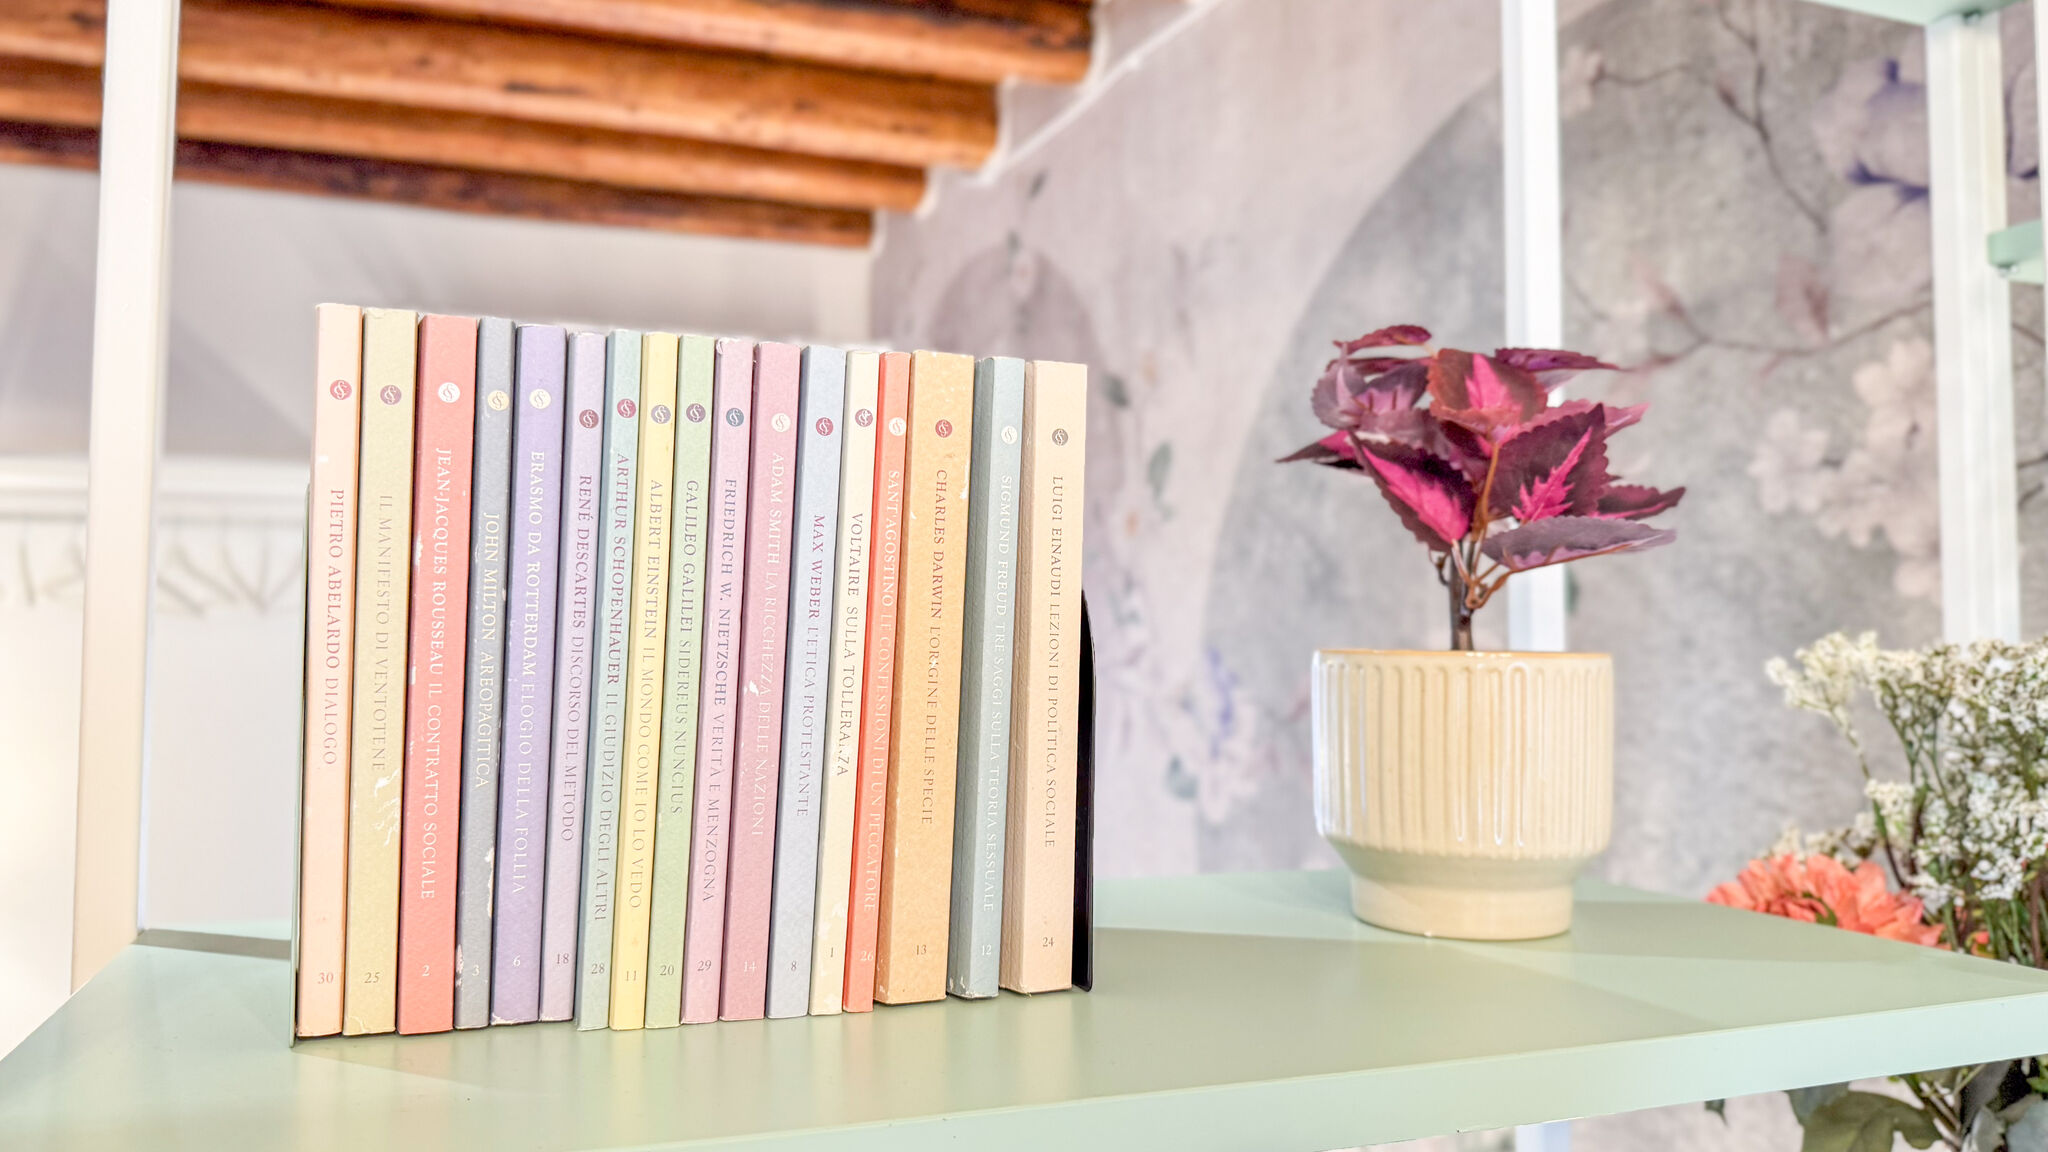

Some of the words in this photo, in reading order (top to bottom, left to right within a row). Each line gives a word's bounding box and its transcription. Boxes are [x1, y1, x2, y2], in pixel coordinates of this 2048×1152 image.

[379, 495, 393, 512] IL
[527, 451, 545, 525] ERASMO
[577, 475, 594, 521] RENÉ
[613, 453, 629, 530] ARTHUR
[769, 453, 785, 504] ADAM
[933, 469, 948, 545] CHARLES
[1051, 476, 1063, 521] LUIGI
[328, 489, 345, 559] PIETRO
[431, 448, 452, 575] JEAN-JACQUES
[483, 512, 500, 562] JOHN
[648, 479, 663, 549] ALBERT
[683, 480, 699, 556] GALILEO
[720, 479, 737, 575] FRIEDRICH
[766, 509, 782, 564] SMITH
[812, 515, 826, 553] MAX
[881, 470, 900, 607] SANT'AGOSTINO
[998, 475, 1013, 555] SIGMUND
[374, 517, 393, 625] MANIFESTO
[527, 532, 542, 556] DA
[847, 513, 863, 597] VOLTAIRE
[1049, 527, 1062, 597] EINAUDI
[481, 568, 498, 641] MILTON
[573, 528, 590, 629] DESCARTES
[644, 555, 660, 639] EINSTEIN
[680, 562, 695, 633] GALILEI
[719, 581, 732, 601] W.
[764, 572, 778, 591] LA
[808, 559, 823, 619] WEBER
[930, 551, 945, 619] DARWIN
[996, 560, 1009, 616] FREUD
[325, 565, 342, 670] ABELARDO
[428, 581, 446, 676] ROUSSEAU
[520, 562, 541, 676] ROTTERDAM
[607, 536, 626, 685] SCHOPENHAUER
[843, 606, 858, 659] SULLA
[880, 614, 893, 634] LE
[994, 624, 1006, 651] TRE
[1048, 604, 1061, 668] LEZIONI
[374, 632, 389, 650] DI
[642, 647, 655, 665] IL
[713, 608, 731, 706] NIETZSCHE
[758, 597, 777, 695] RICCHEZZA
[803, 627, 819, 688] L'ETICA
[426, 683, 442, 698] IL
[568, 636, 584, 723] DISCORSO
[606, 693, 618, 709] IL
[638, 669, 654, 738] MONDO
[675, 639, 691, 725] SIDEREUS
[871, 637, 891, 751] CONFESSIONI
[992, 656, 1004, 705] SAGGI
[1047, 675, 1059, 691] DI
[322, 678, 339, 765] DIALOGO
[371, 658, 389, 772] VENTOTENE
[475, 652, 495, 789] AREOPAGITICA
[517, 682, 535, 756] ELOGIO
[755, 702, 773, 752] DELLE
[836, 665, 855, 776] TOLLERAZA
[924, 714, 937, 764] DELLE
[989, 711, 1001, 761] SULLA
[1046, 698, 1058, 774] POLITICA
[423, 704, 441, 817] CONTRATTO
[565, 728, 579, 761] DEL
[601, 714, 618, 803] GIUDIZIO
[634, 743, 650, 796] COME
[670, 730, 686, 814] NUNCIUS
[796, 695, 815, 817] PROTESTANTE
[871, 758, 884, 774] DI
[514, 762, 532, 820] DELLA
[561, 766, 577, 841] METODO
[633, 803, 647, 822] IO
[708, 784, 721, 792] E
[751, 758, 769, 836] NAZIONI
[870, 782, 883, 804] UN
[921, 768, 935, 825] SPECIE
[986, 767, 1000, 829] TEORIA
[1044, 779, 1056, 848] SOCIALE
[420, 821, 437, 900] SOCIALE
[511, 827, 530, 894] FOLLIA
[597, 810, 613, 862] DEGLI
[631, 829, 645, 851] LO
[702, 799, 721, 901] MENZOGNA
[864, 813, 881, 912] PECCATORE
[594, 869, 608, 921] ALTRI
[629, 858, 644, 909] VEDO
[983, 835, 997, 912] SESSUALE
[422, 965, 430, 977] 2
[472, 964, 480, 976] 3
[513, 955, 521, 967] 6
[555, 953, 570, 964] 18
[591, 963, 605, 974] 28
[659, 964, 675, 976] 20
[697, 960, 712, 972] 29
[743, 961, 757, 972] 14
[790, 961, 797, 972] 8
[829, 947, 834, 958] 1
[860, 951, 874, 962] 26
[916, 944, 927, 955] 13
[981, 944, 992, 955] 12
[1042, 937, 1054, 948] 24
[318, 972, 334, 984] 30
[364, 972, 380, 984] 25
[625, 970, 637, 981] 11
